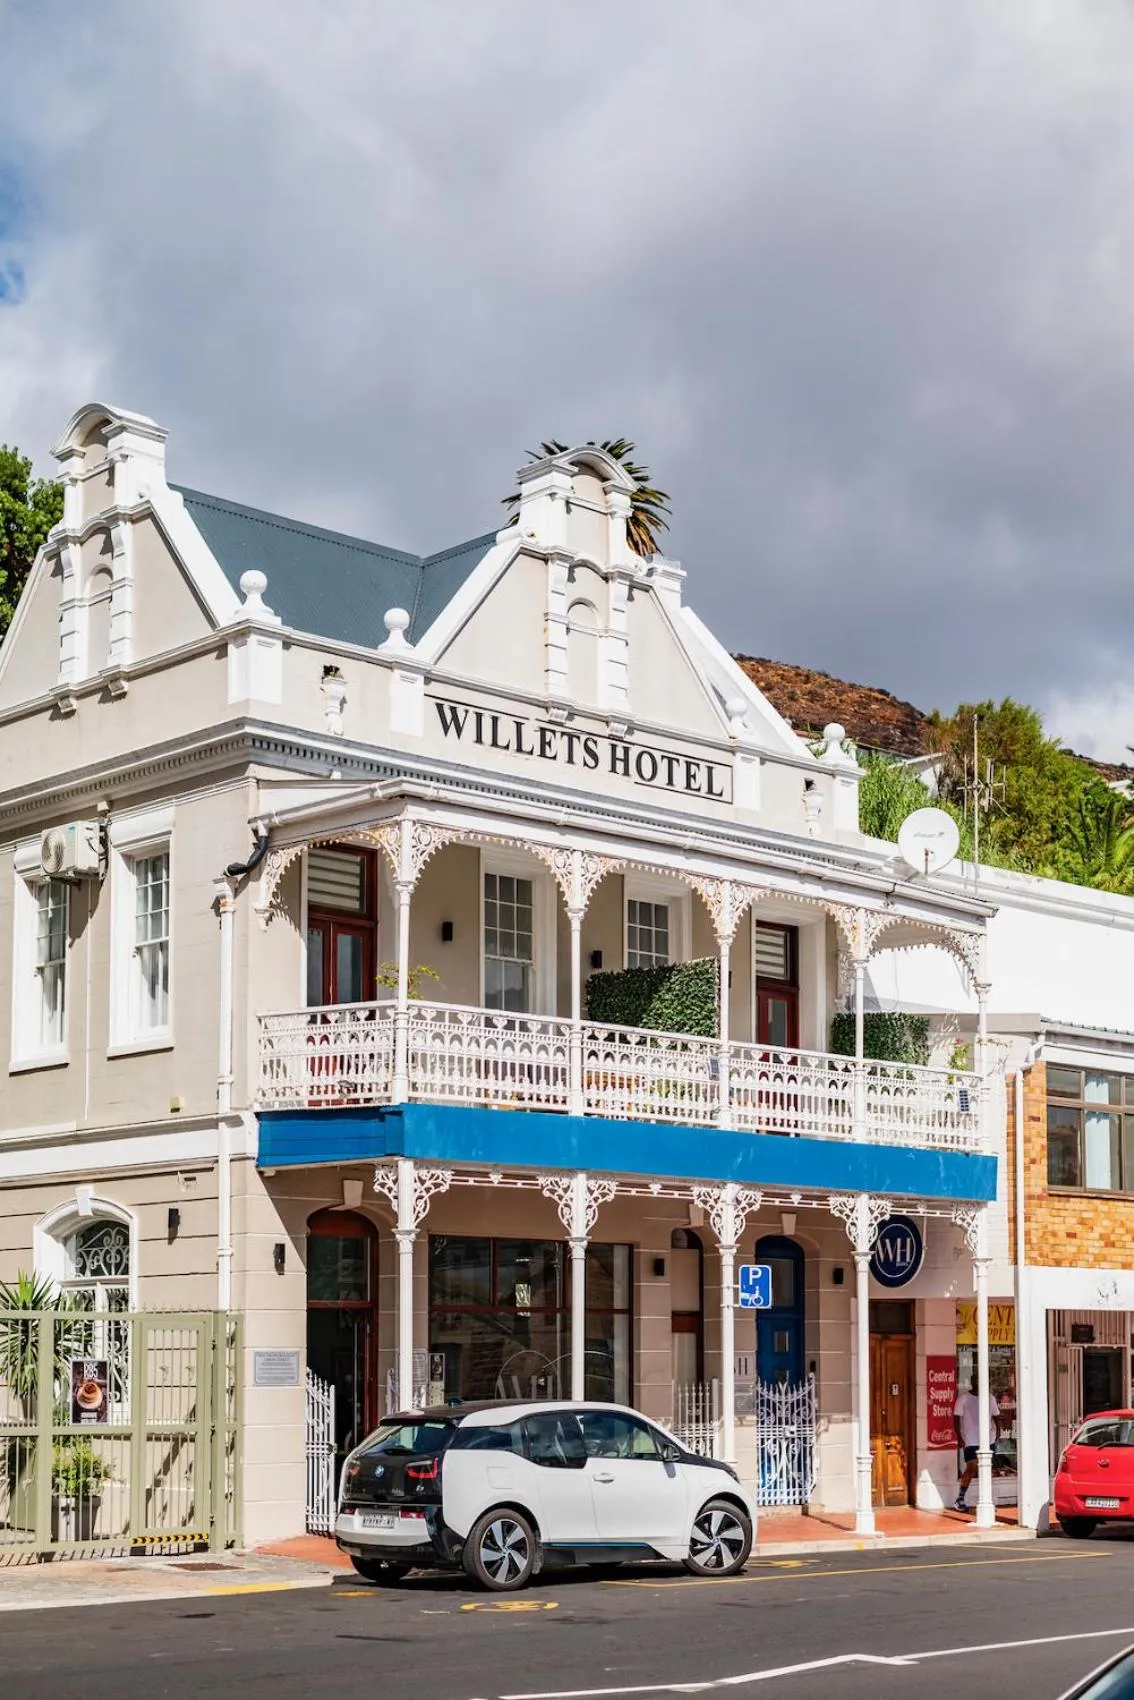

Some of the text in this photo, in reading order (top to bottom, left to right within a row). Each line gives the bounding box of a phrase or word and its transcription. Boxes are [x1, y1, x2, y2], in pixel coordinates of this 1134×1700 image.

[435, 702, 724, 798] WILLETS HOTEL
[876, 1237, 911, 1263] WH
[749, 1267, 762, 1285] P
[928, 1370, 955, 1383] Central
[930, 1387, 954, 1402] Supply
[932, 1404, 953, 1417] Store
